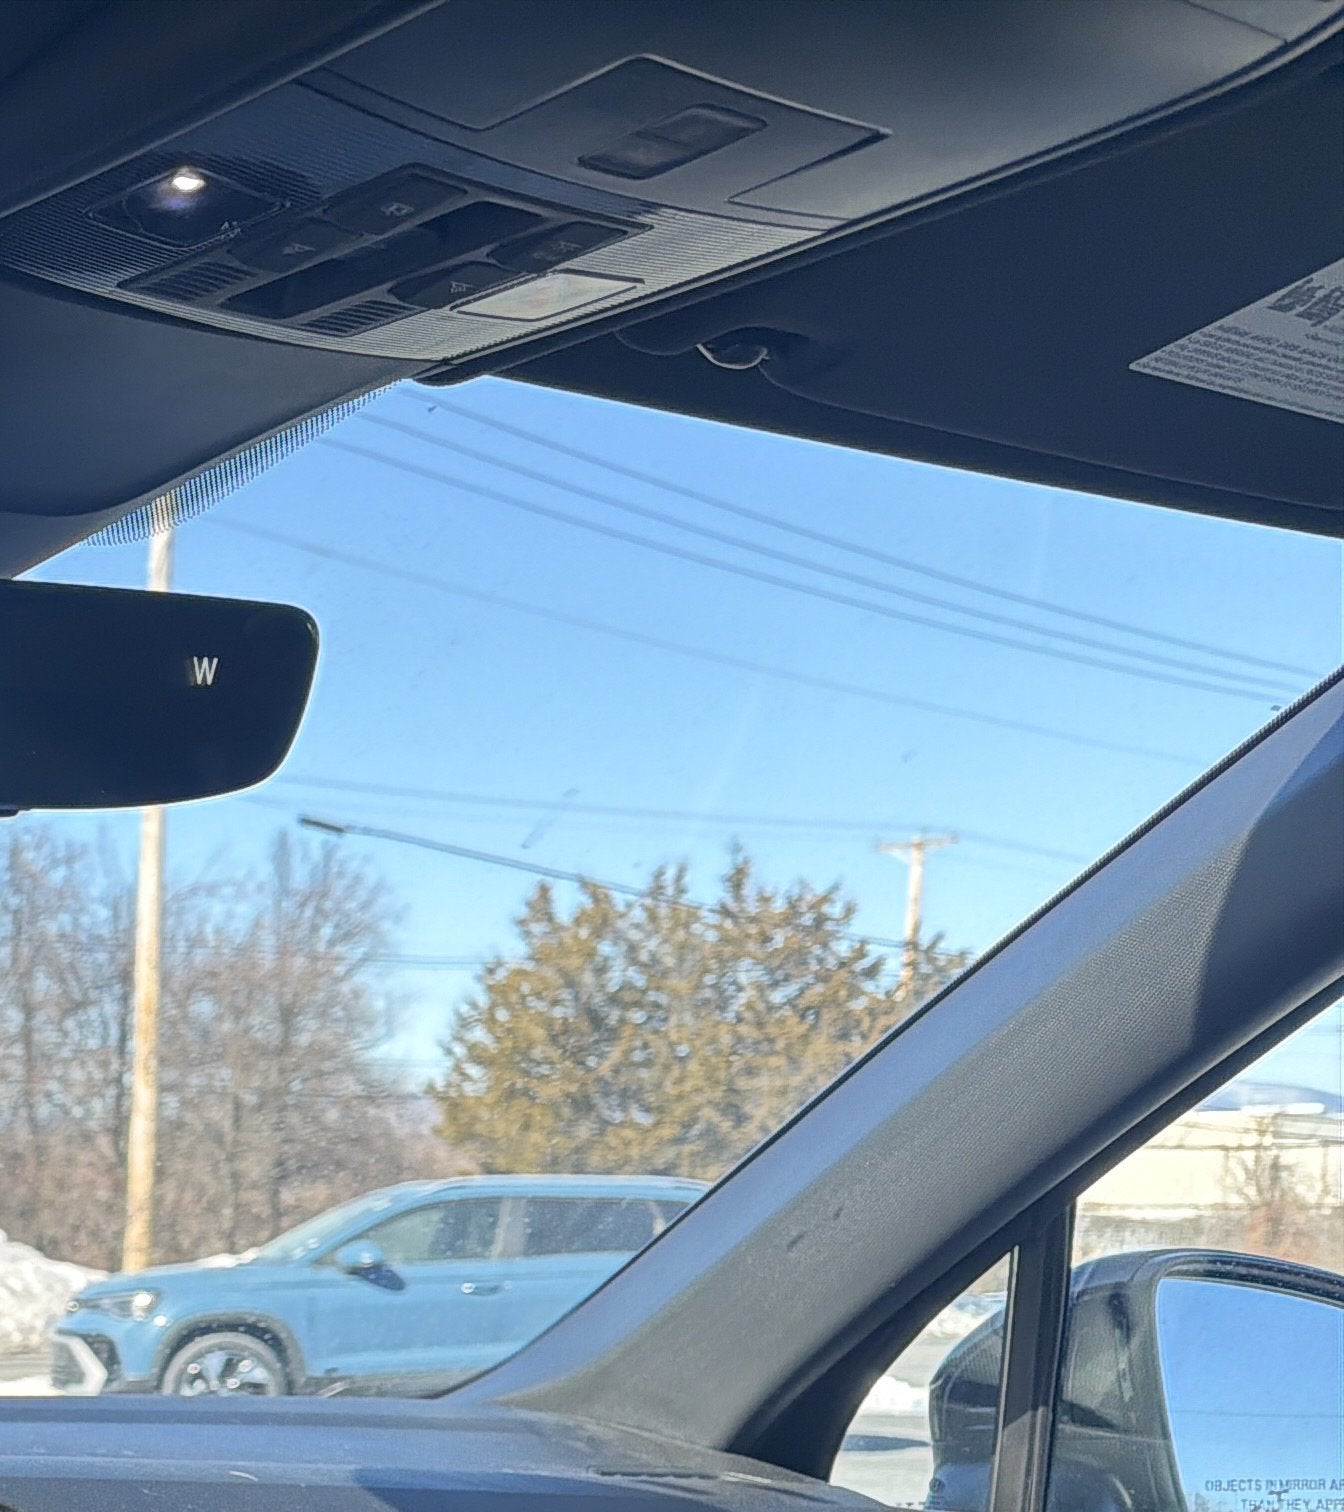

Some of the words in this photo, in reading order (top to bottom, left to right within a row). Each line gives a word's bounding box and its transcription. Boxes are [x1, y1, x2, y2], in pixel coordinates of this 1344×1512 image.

[193, 656, 218, 686] W
[1205, 1479, 1262, 1492] OBJECTS
[1278, 1479, 1326, 1490] MIRROR
